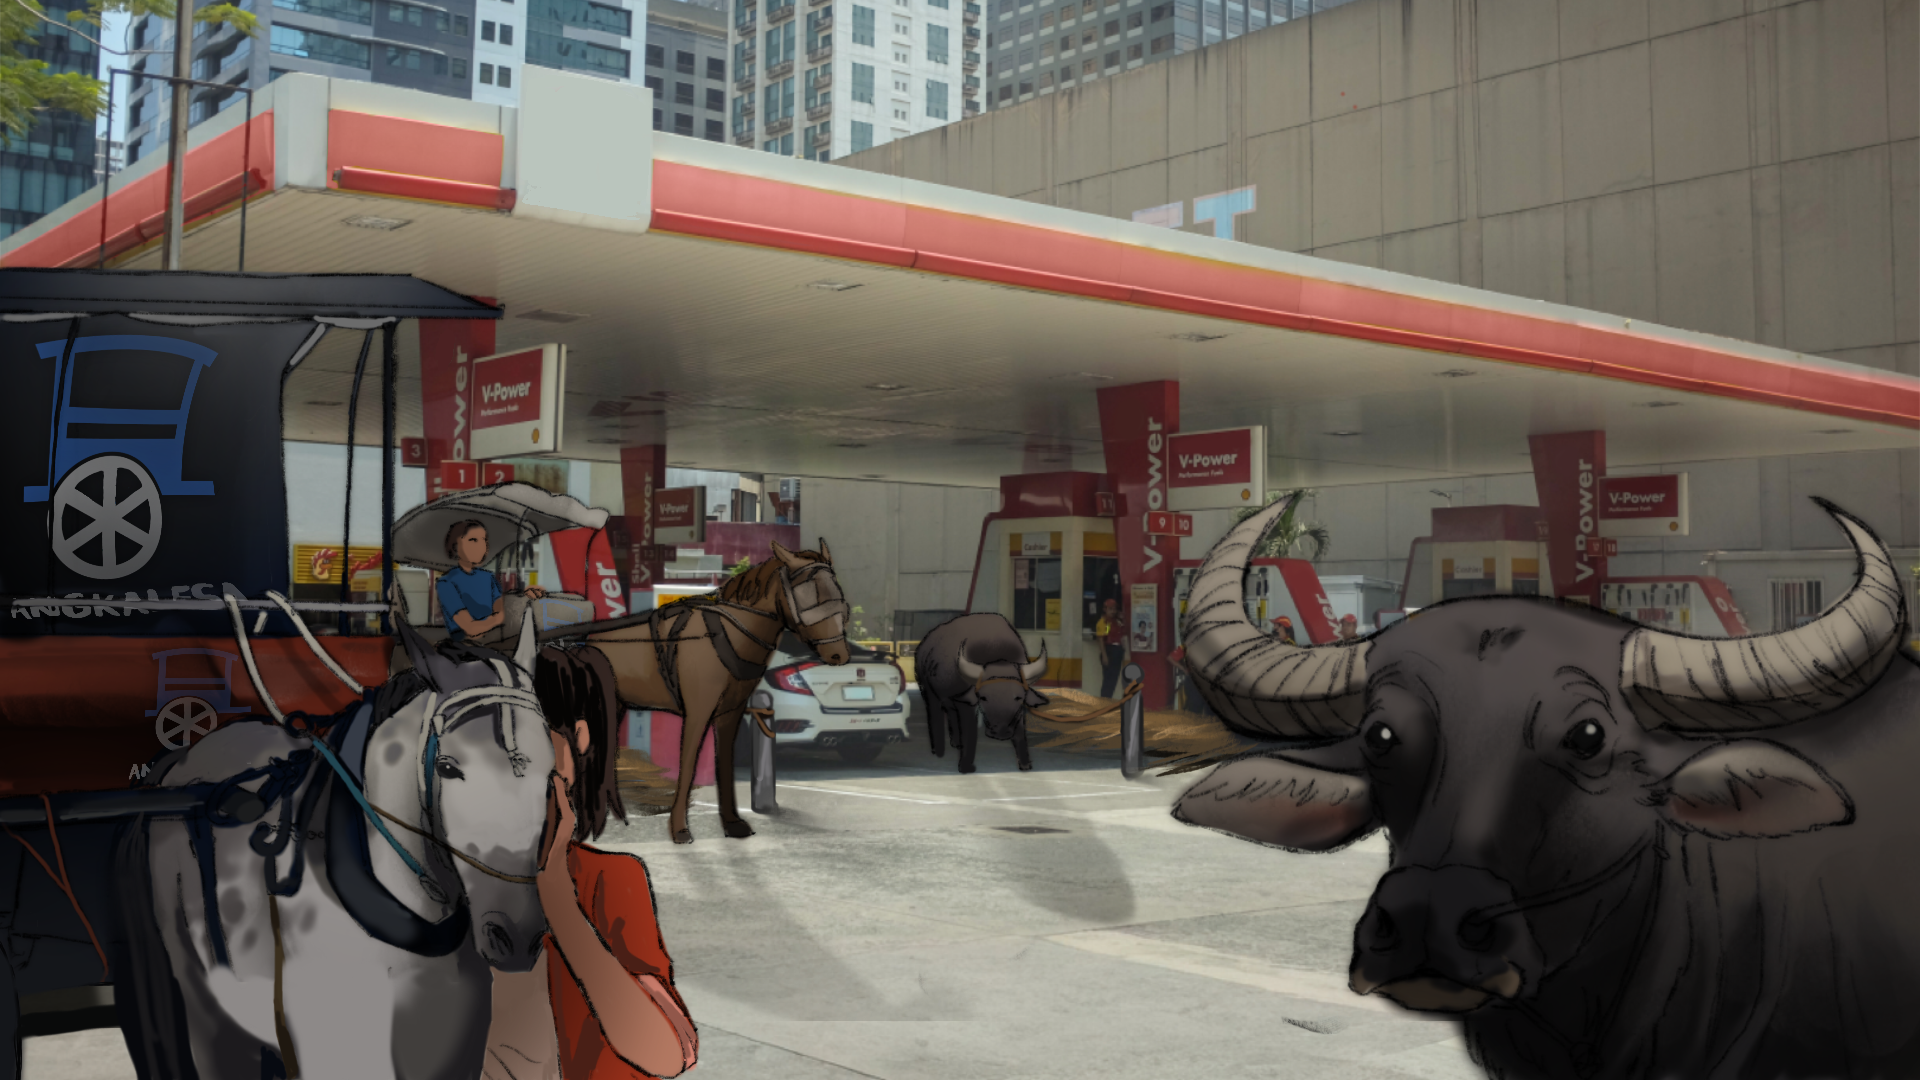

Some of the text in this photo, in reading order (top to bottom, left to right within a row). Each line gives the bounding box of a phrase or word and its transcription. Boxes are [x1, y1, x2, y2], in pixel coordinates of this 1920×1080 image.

[481, 381, 532, 404] V-Power
[410, 443, 422, 459] 3
[1178, 452, 1239, 469] V-Power
[458, 468, 466, 484] 1
[494, 469, 506, 484] 2
[1101, 497, 1114, 509] 11
[1608, 491, 1666, 504] V-Power
[1158, 516, 1166, 528] 9
[1178, 518, 1190, 530] 10
[1574, 458, 1594, 583] V-Power
[1024, 543, 1048, 551] Cashier
[631, 543, 641, 585] Shell
[1455, 565, 1483, 574] Cashier
